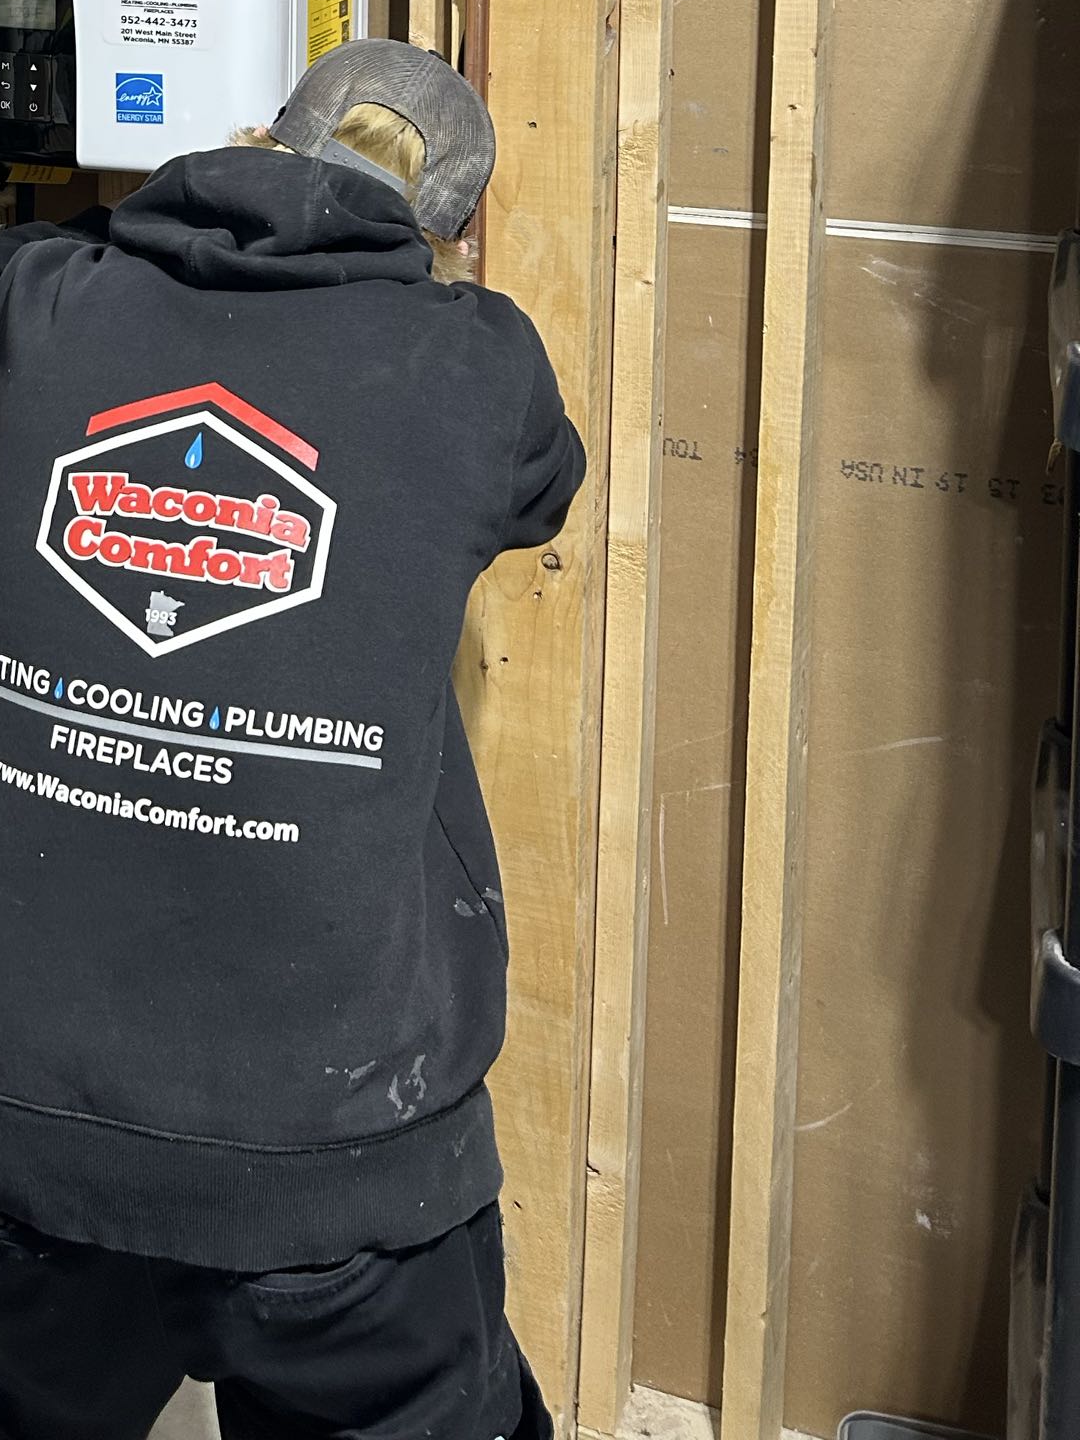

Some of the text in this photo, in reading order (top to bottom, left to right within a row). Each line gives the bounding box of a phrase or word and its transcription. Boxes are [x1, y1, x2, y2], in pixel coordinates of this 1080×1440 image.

[120, 15, 198, 28] 952-442-3473
[123, 35, 156, 44] Waconia,
[171, 38, 194, 46] 55387
[174, 31, 197, 39] Street
[0, 101, 11, 110] OK
[117, 112, 162, 122] ENERGY STAR
[662, 437, 703, 461] TOU
[839, 458, 886, 483] USA
[892, 465, 926, 490] IN
[68, 472, 312, 553] Waconia
[63, 518, 295, 593] Comfort
[144, 607, 178, 627] 1993
[67, 679, 205, 729] COOLING
[224, 706, 386, 752] PLUMBING
[50, 724, 235, 785] FIREPLACES
